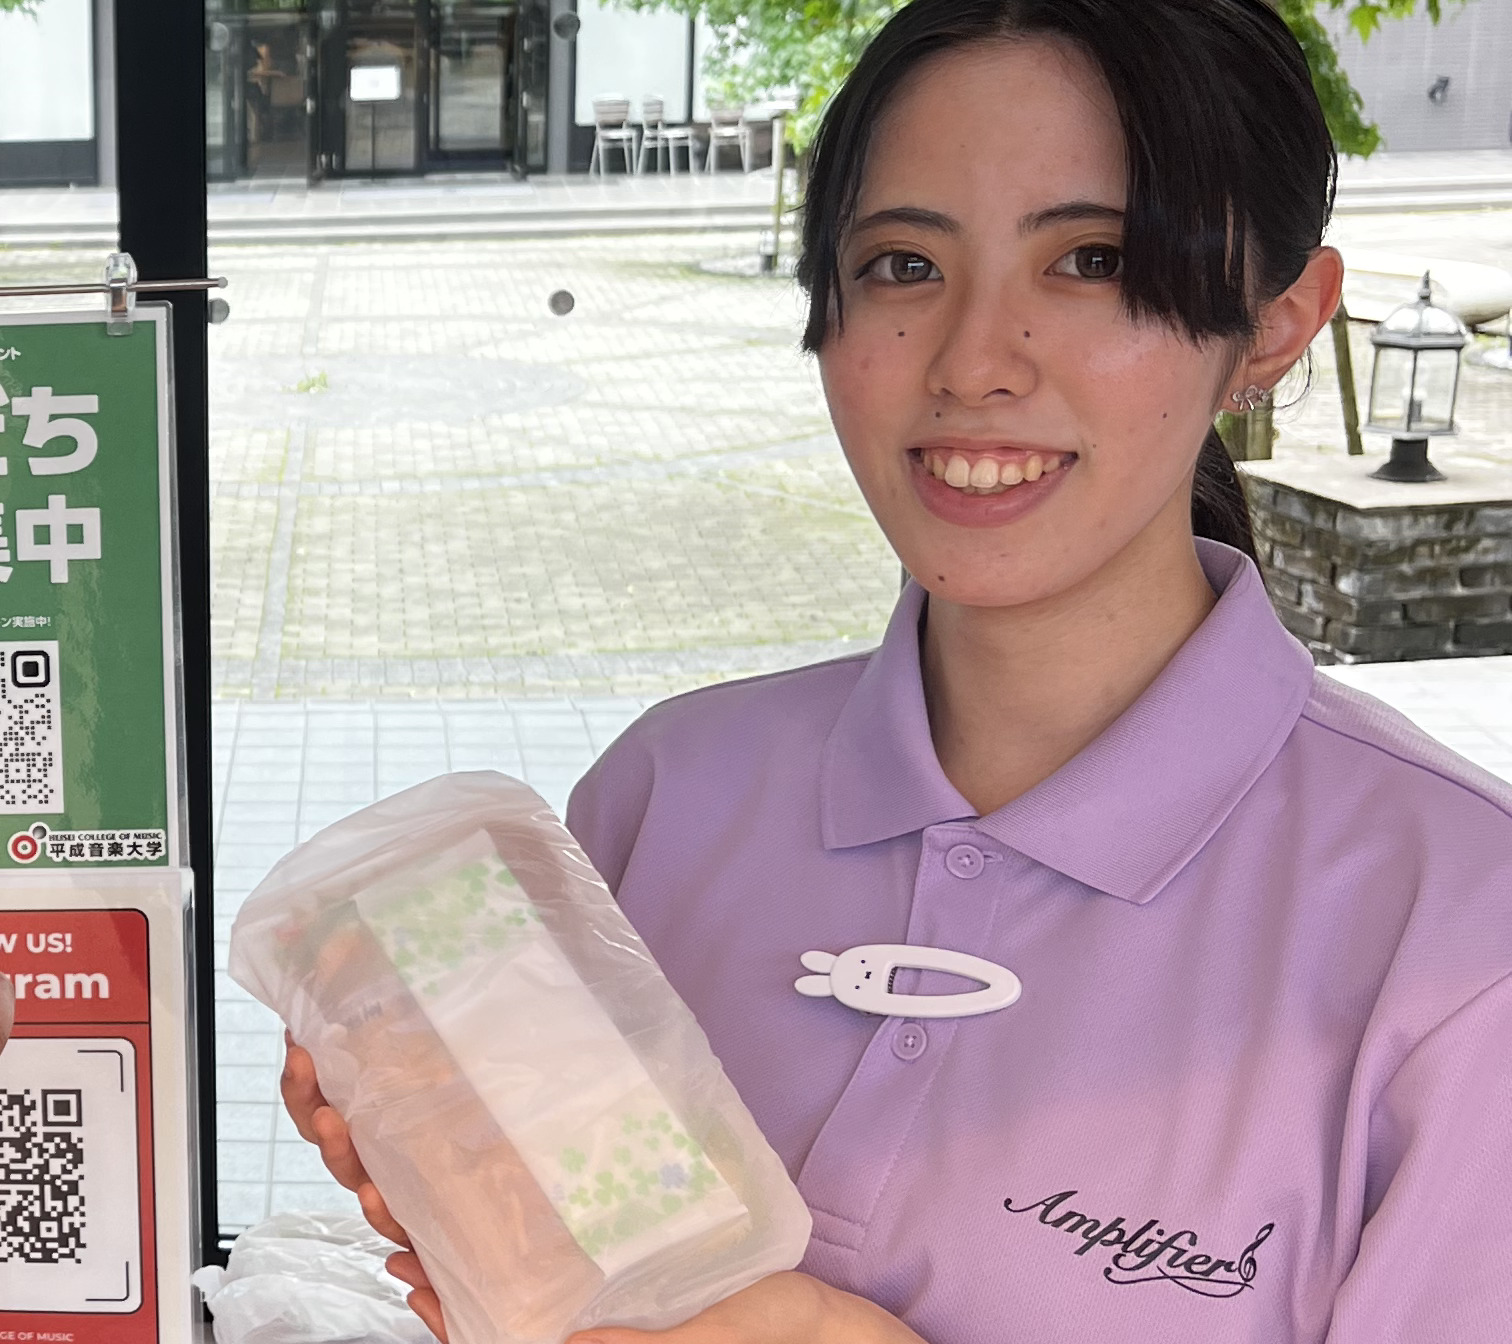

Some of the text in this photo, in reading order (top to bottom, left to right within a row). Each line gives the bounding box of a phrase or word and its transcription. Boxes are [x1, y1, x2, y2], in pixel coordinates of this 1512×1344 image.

[77, 833, 116, 841] COLLEGE
[118, 833, 131, 841] OF
[133, 832, 162, 841] MUSIC
[50, 842, 163, 857] 平成音楽大学
[26, 932, 73, 954] US!
[9, 972, 110, 999] ram
[1003, 1190, 1238, 1279] Amplifier
[18, 1331, 34, 1341] OF
[37, 1332, 74, 1342] MUSIC
